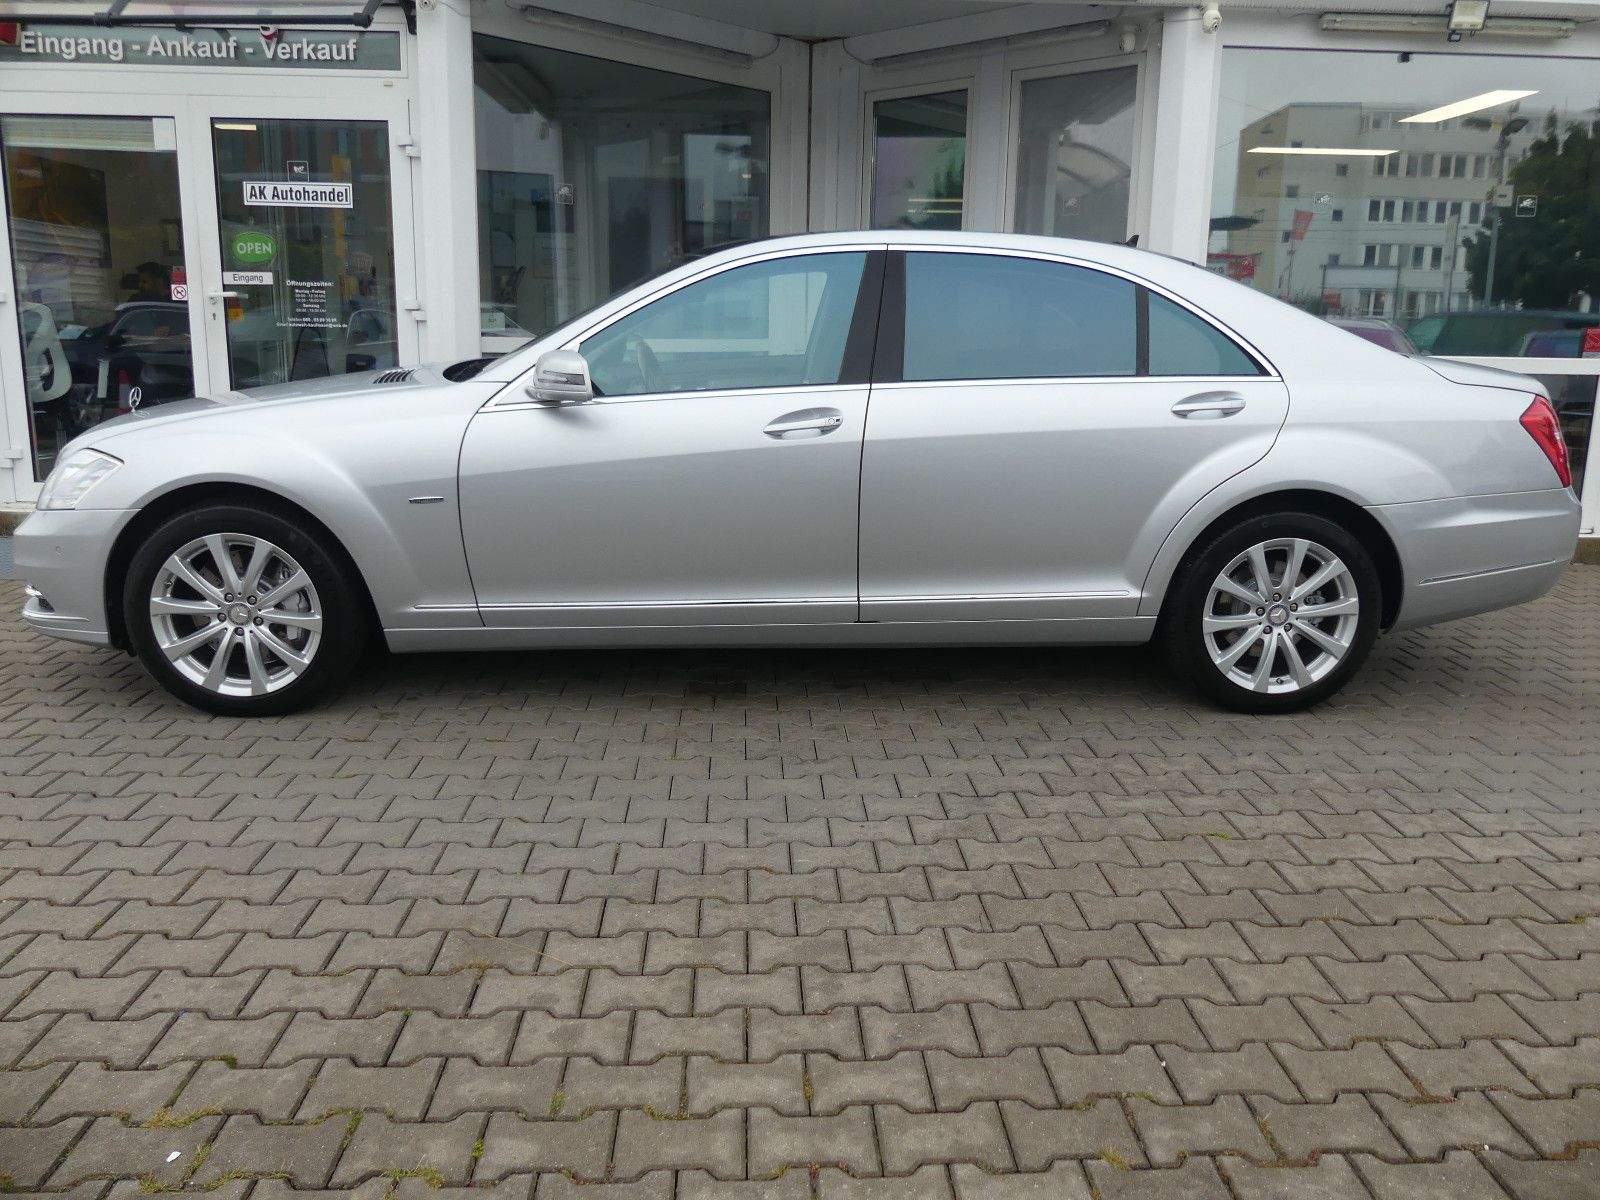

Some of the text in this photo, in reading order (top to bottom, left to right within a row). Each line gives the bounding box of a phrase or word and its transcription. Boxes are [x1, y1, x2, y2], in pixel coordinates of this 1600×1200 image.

[20, 31, 123, 61] Eingang
[147, 34, 239, 59] Ankauf
[261, 36, 358, 61] Verkauf
[249, 185, 349, 203] AK Autohandel
[236, 242, 272, 255] OPEN
[232, 273, 264, 283] Eingang
